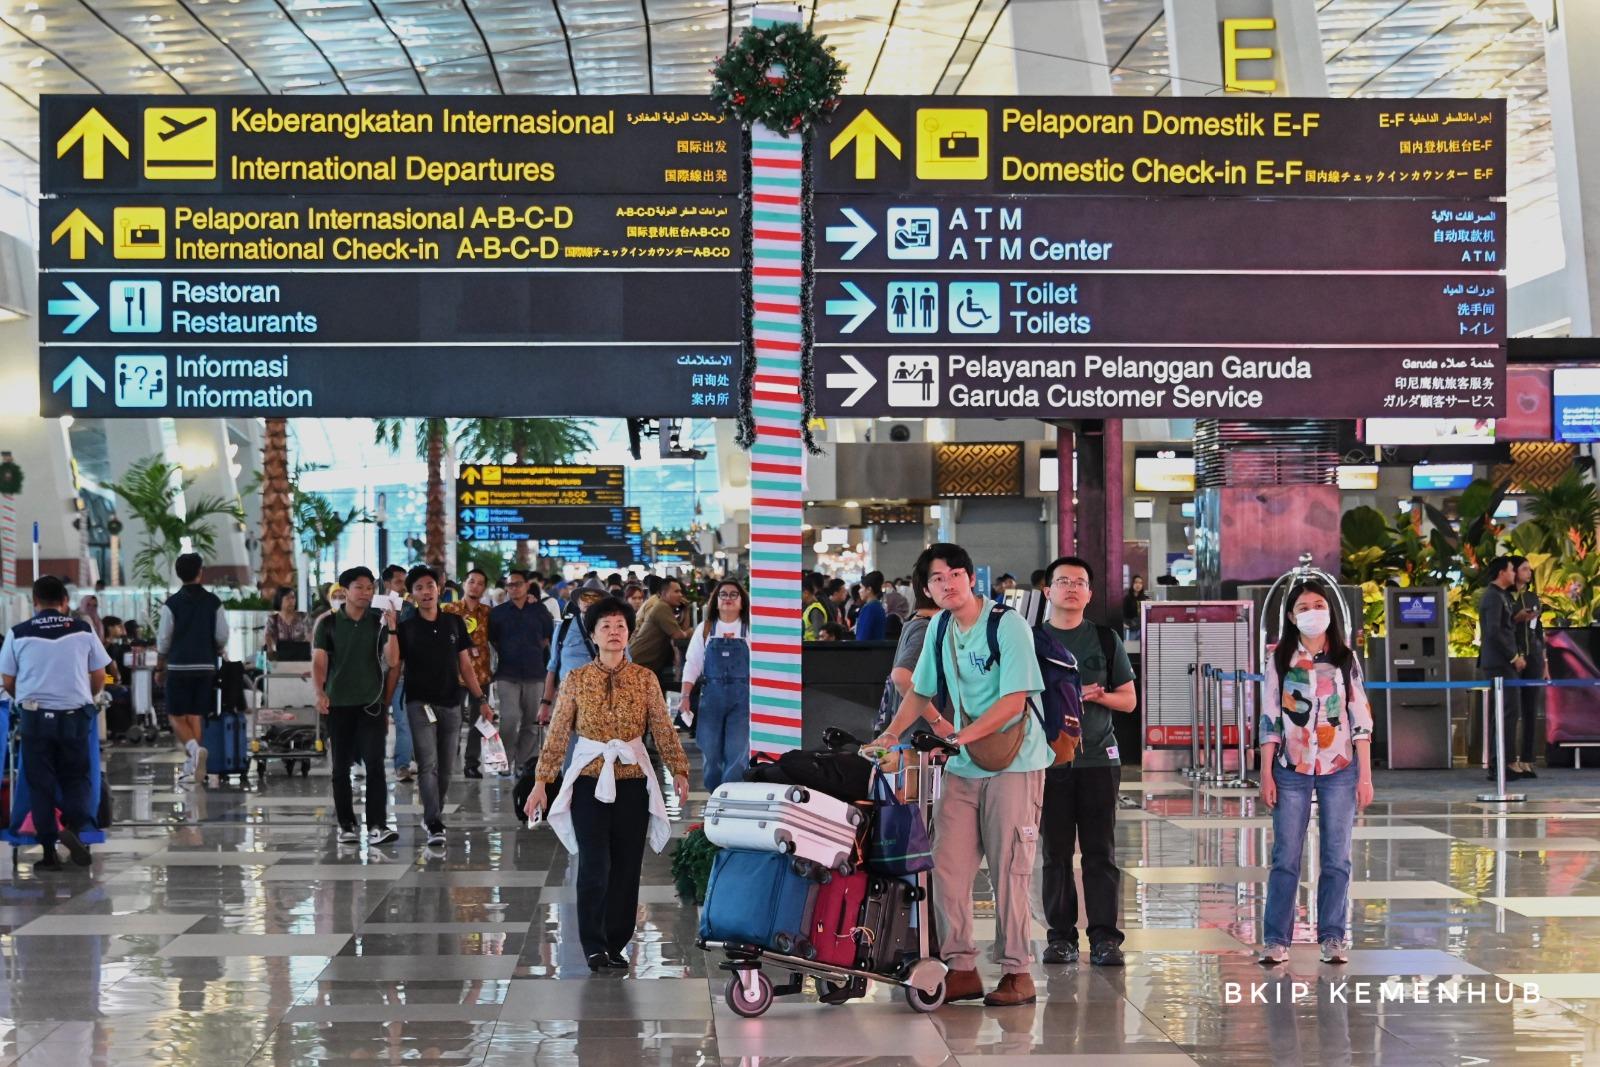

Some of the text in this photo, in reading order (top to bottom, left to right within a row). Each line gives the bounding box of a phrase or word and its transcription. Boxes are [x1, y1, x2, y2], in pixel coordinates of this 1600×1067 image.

[1224, 18, 1277, 92] E
[231, 107, 614, 139] Keberangkatan Internasional
[1002, 107, 1321, 140] Pelaporan Domestik E-F
[1379, 113, 1406, 128] E-F
[676, 139, 727, 154] 国际出发
[231, 154, 555, 187] International Departures
[664, 168, 728, 183] 国際線出発
[1002, 155, 1303, 185] Domestic Check-in E-F
[1473, 167, 1494, 180] E-F
[174, 205, 574, 234] Pelaporan Internasional A-B-C-D
[615, 207, 655, 217] A-B-C-D
[175, 231, 560, 261] International Check-in A-B-C-D
[1029, 236, 1114, 261] Center
[1433, 228, 1496, 244] 自动取款机
[172, 280, 281, 304] Restoran
[1009, 280, 1079, 305] Toilet
[172, 309, 318, 334] Restaurants
[1456, 302, 1497, 317] 洗手间
[1009, 310, 1092, 335] Toilets
[1458, 322, 1495, 336] トイレ
[176, 353, 289, 378] Informasi
[948, 354, 1313, 385] Pelayanan Pelanggan Garuda
[1402, 358, 1438, 370] Garuda
[691, 373, 730, 387] 问询处
[176, 383, 313, 408] Information
[690, 392, 730, 406] 案内所
[948, 383, 1264, 409] Garuda Customer Service
